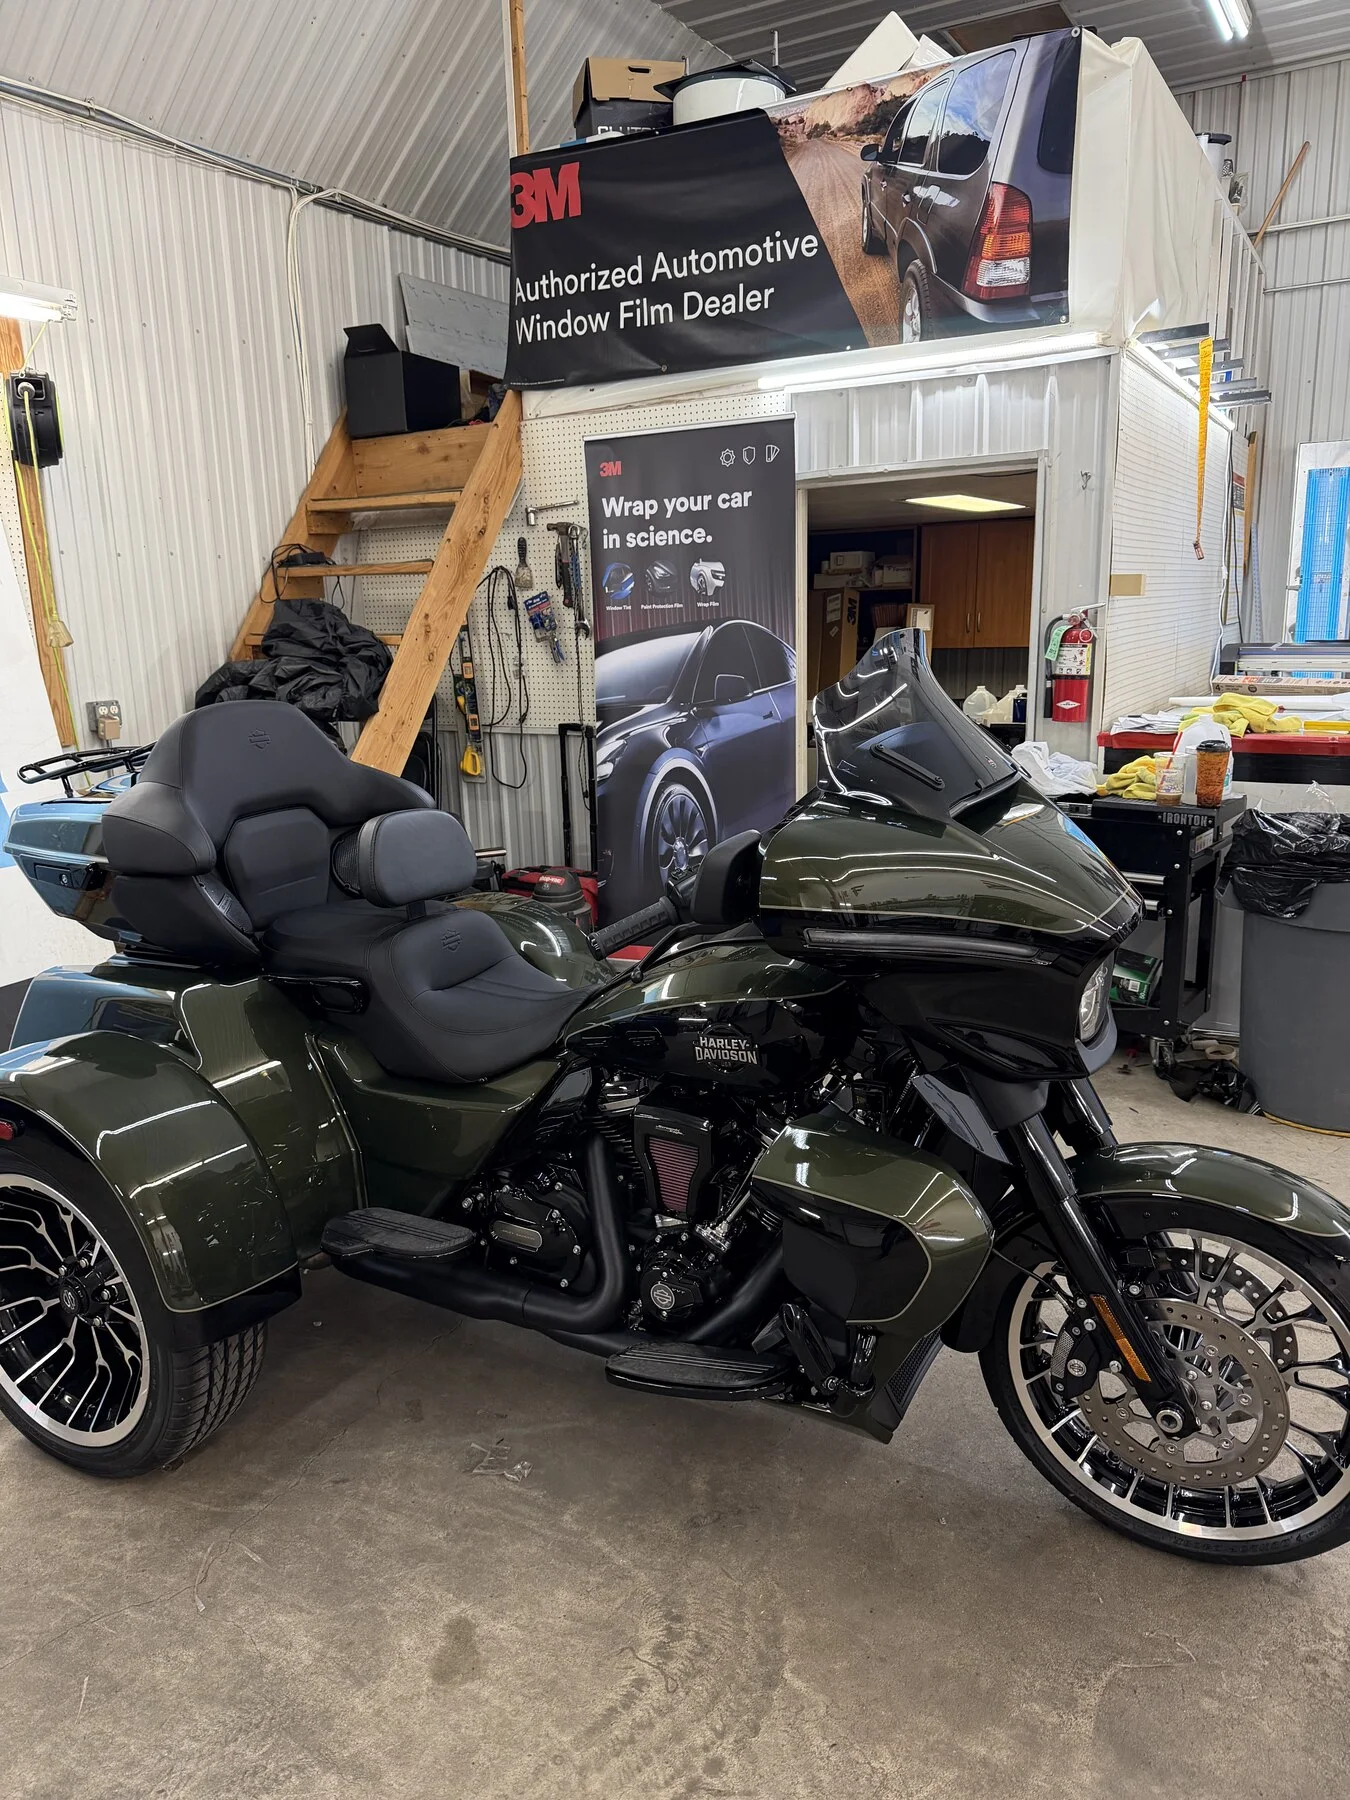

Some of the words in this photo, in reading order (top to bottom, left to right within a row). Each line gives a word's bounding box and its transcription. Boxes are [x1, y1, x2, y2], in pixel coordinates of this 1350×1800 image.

[510, 162, 581, 229] 3M
[515, 255, 643, 305] Authorized
[651, 230, 818, 282] Automotive
[515, 309, 610, 345] Window
[619, 297, 673, 329] Film
[683, 283, 775, 321] Dealer
[600, 460, 622, 477] 3M
[601, 496, 659, 520] Wrap
[663, 494, 712, 519] your
[717, 490, 752, 509] car
[602, 528, 620, 549] in
[626, 525, 713, 548] science.
[695, 1046, 758, 1065] DAVIDSON
[700, 1036, 750, 1050] HARLEY-
